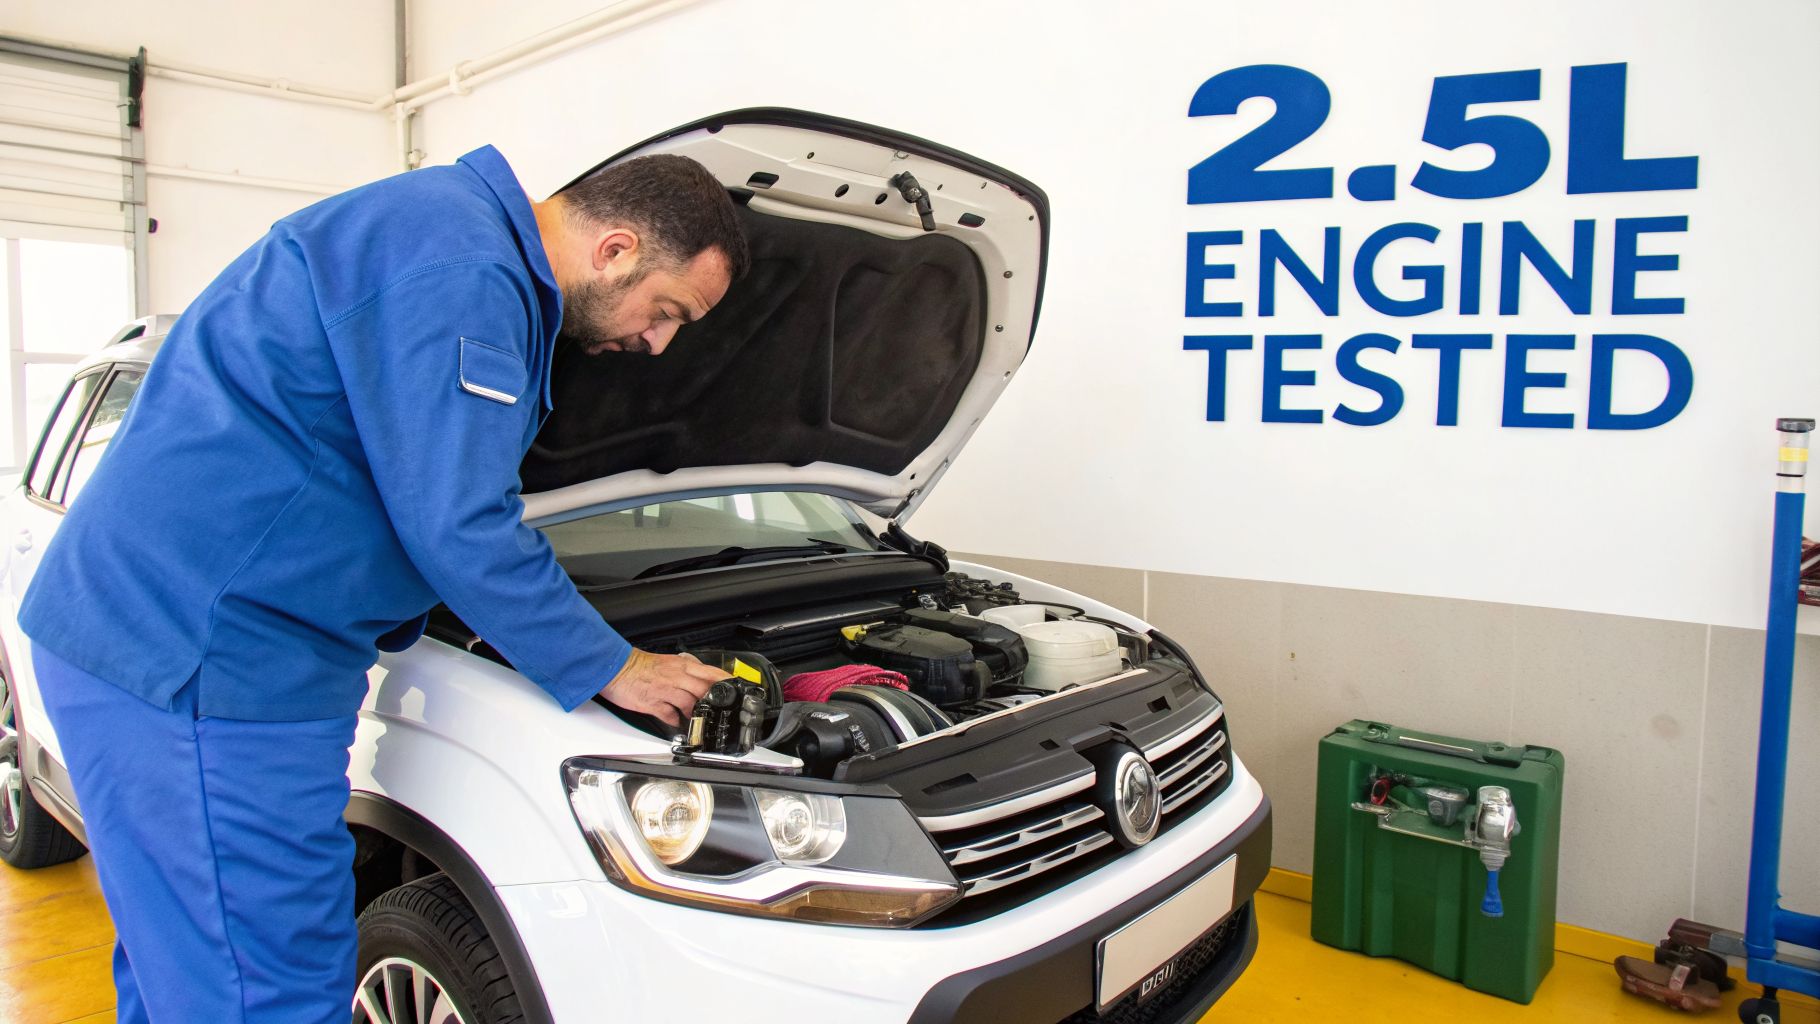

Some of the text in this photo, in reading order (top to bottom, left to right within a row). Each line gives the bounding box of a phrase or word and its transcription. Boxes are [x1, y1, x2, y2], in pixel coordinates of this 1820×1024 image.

[1187, 62, 1699, 204] 2.5L
[1185, 215, 1689, 318] ENGINE
[1183, 333, 1694, 430] TESTED
